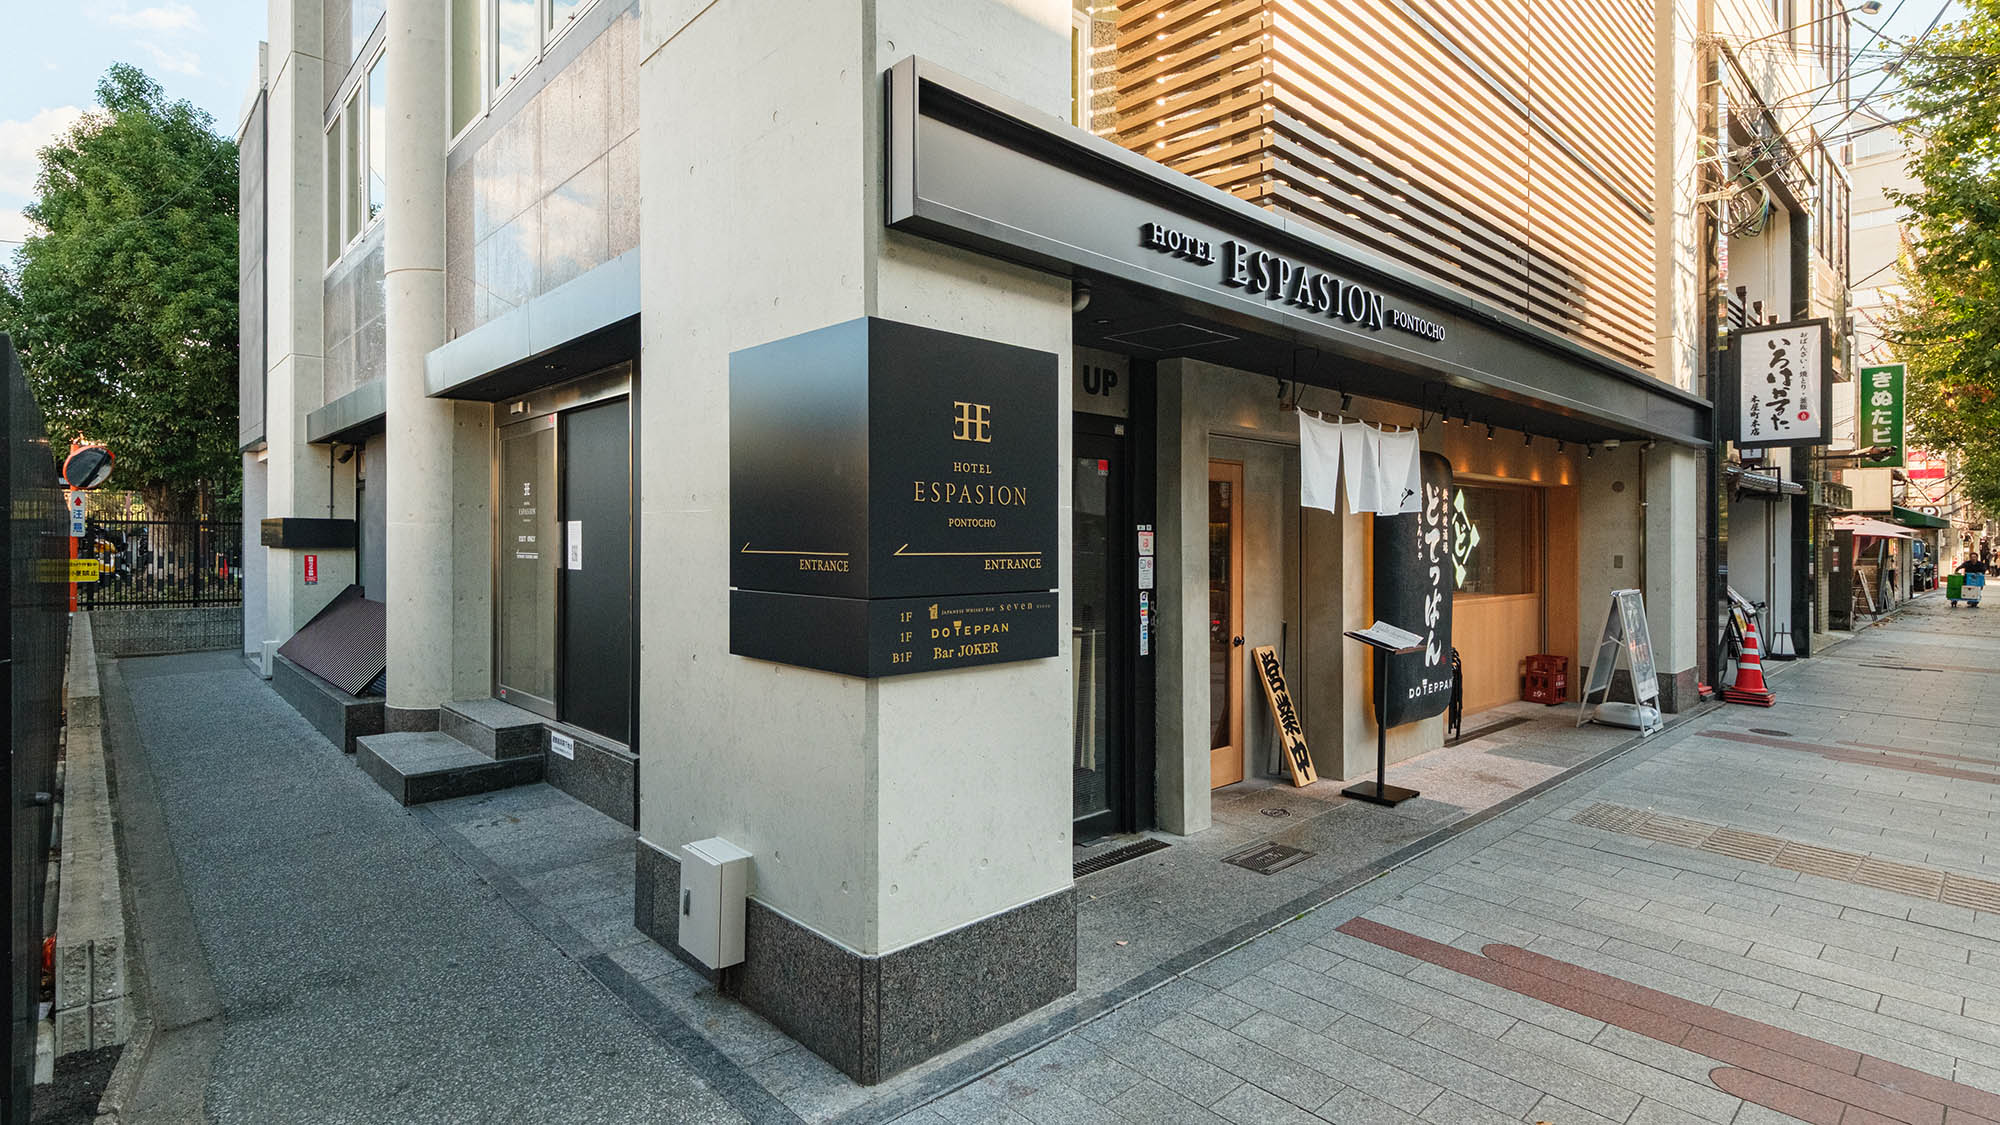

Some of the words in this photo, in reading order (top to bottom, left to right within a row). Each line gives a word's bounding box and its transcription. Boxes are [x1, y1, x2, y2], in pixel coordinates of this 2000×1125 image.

[1152, 222, 1216, 263] HOTEL
[1231, 240, 1385, 330] ESPASION
[1393, 309, 1446, 341] PONTOCHO
[1083, 365, 1118, 396] UP
[1871, 371, 1893, 462] きぬたビ
[953, 462, 993, 474] HOTEL
[913, 481, 1027, 506] ESPASION
[948, 518, 997, 528] PONTOCHO
[1454, 521, 1467, 557] ど
[799, 559, 849, 572] ENTRANCE
[984, 558, 1042, 570] ENTRANCE
[1425, 482, 1442, 668] どてっぱん
[999, 602, 1033, 612] seven
[900, 612, 913, 623] 1F
[900, 632, 913, 643] 1F
[931, 622, 1010, 639] DOTEPPAN
[892, 652, 913, 664] B1F
[933, 646, 955, 660] Bar
[958, 641, 999, 657] JOKER
[1260, 650, 1310, 781] 営業中
